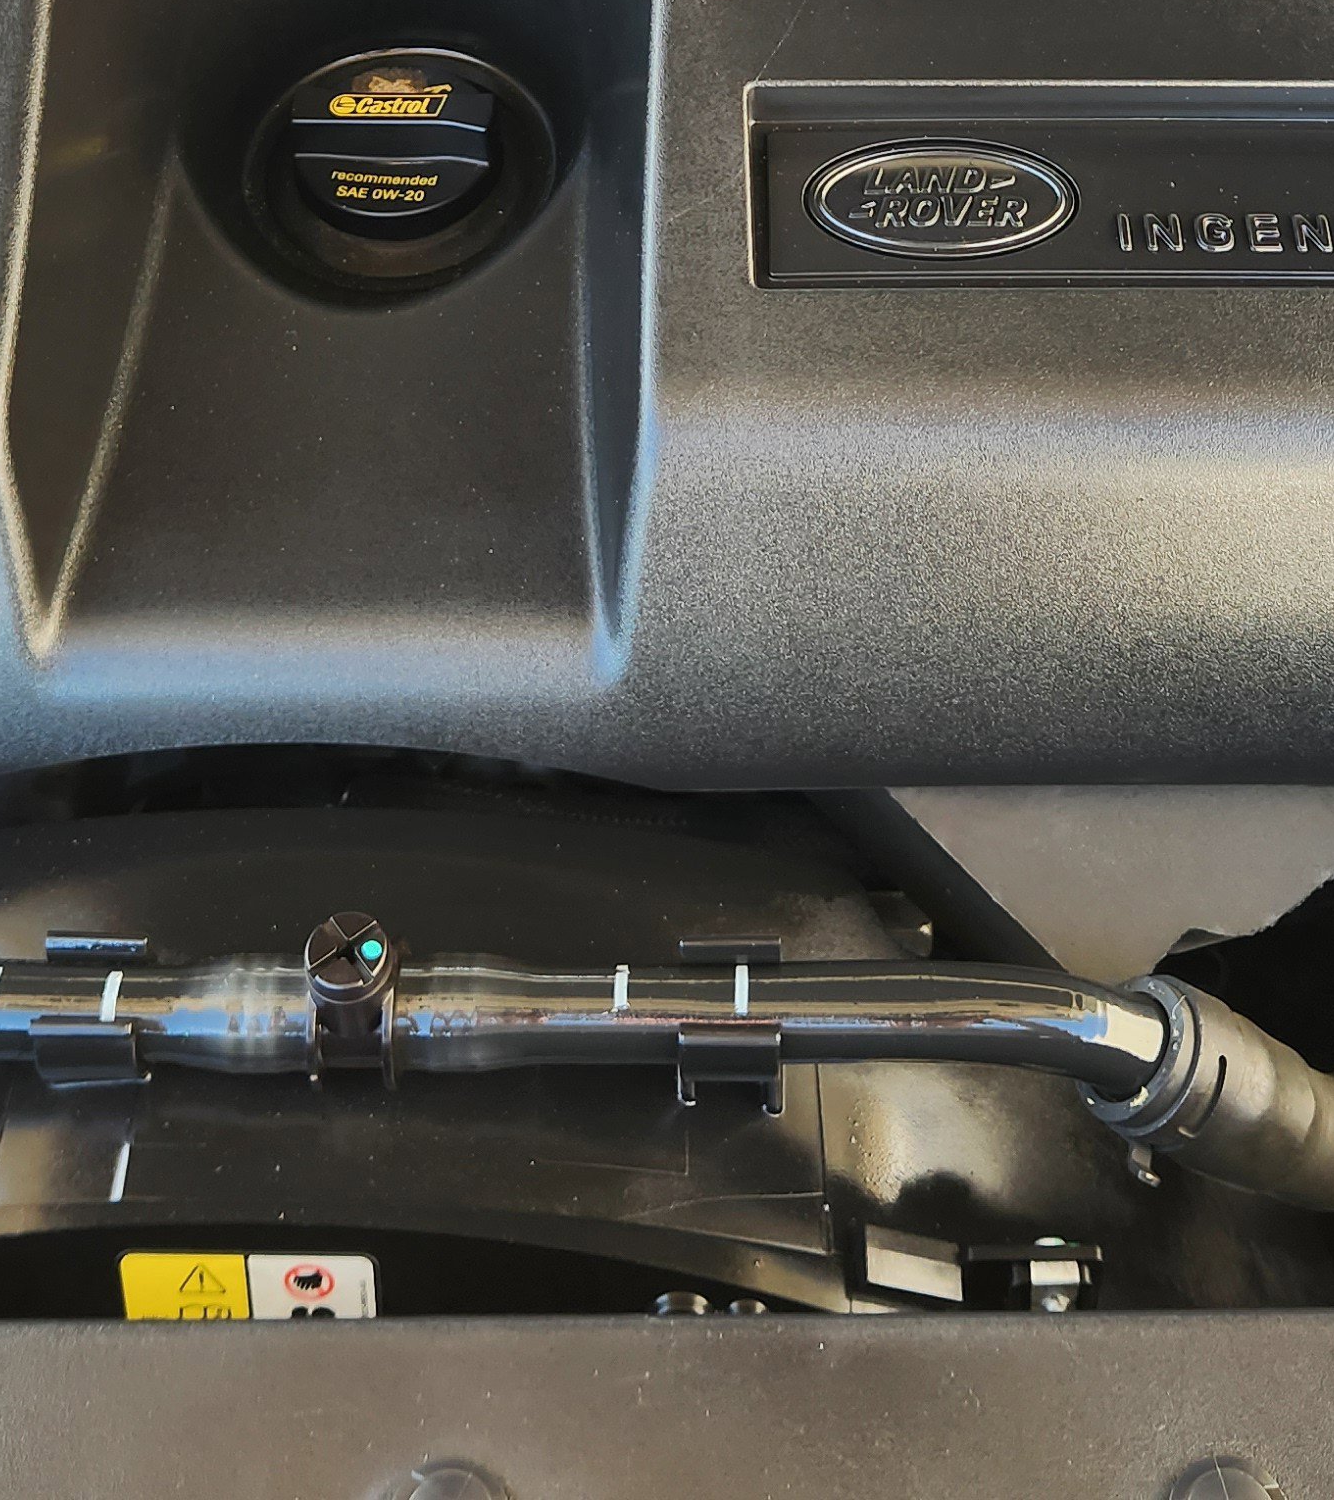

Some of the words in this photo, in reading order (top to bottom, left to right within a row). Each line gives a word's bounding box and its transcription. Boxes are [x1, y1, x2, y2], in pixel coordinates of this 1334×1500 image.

[355, 97, 431, 114] Castrol
[331, 170, 438, 186] recommended
[864, 166, 987, 195] LAND
[336, 185, 369, 199] SAE
[372, 188, 425, 202] 0W-20
[874, 196, 1030, 228] ROVER
